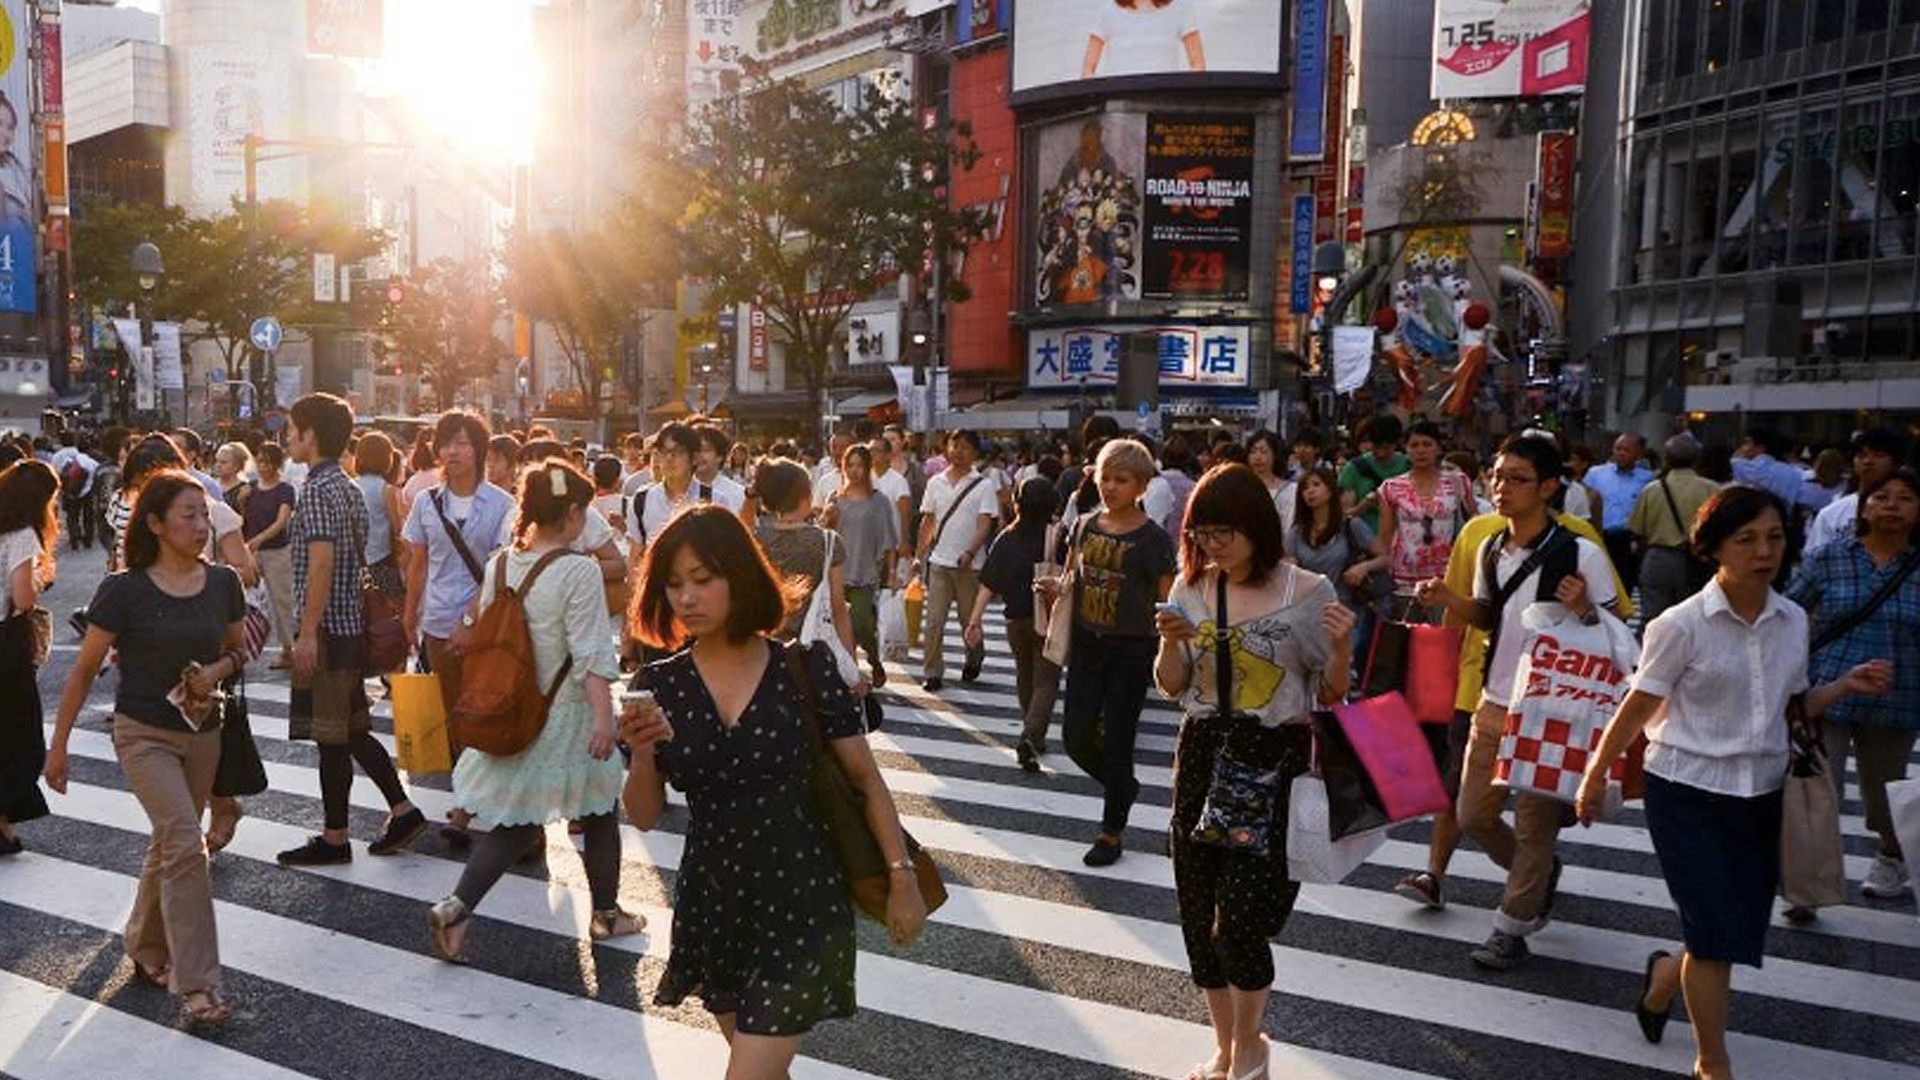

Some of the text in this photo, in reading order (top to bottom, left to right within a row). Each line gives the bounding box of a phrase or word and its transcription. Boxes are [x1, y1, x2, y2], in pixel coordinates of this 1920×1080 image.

[1146, 179, 1250, 197] ROAD TO NINJA
[1168, 249, 1225, 281] 7.28
